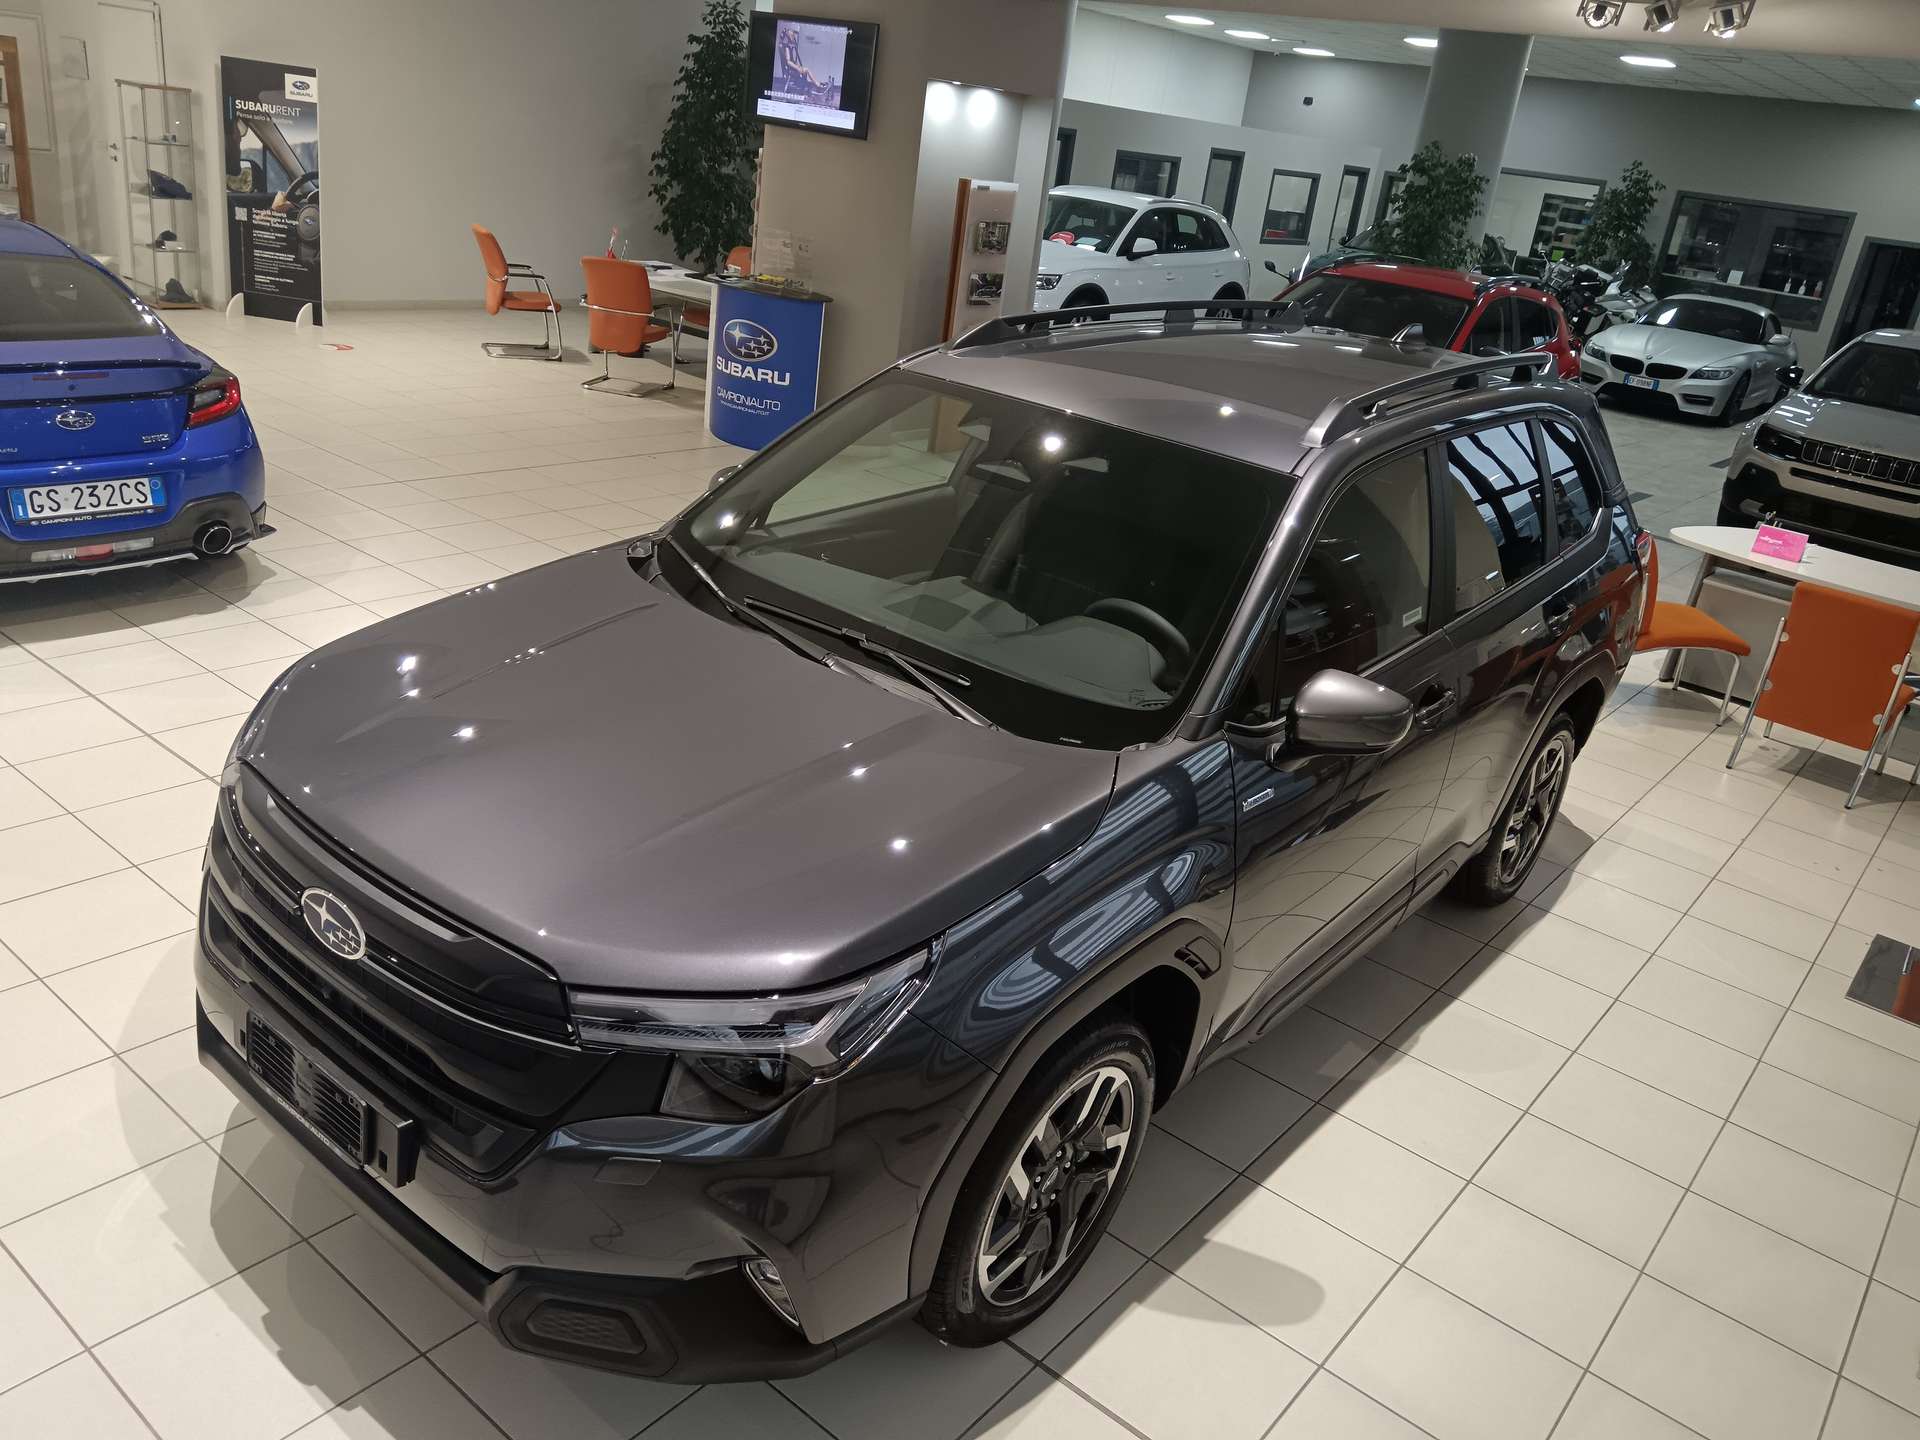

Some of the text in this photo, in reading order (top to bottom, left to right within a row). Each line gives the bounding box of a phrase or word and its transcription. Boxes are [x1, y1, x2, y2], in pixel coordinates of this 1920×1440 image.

[235, 99, 302, 117] SUBARURENT
[236, 111, 253, 119] Pensa
[716, 355, 791, 386] SUBARU
[28, 481, 148, 514] GS 232CS
[74, 514, 93, 523] AUTO
